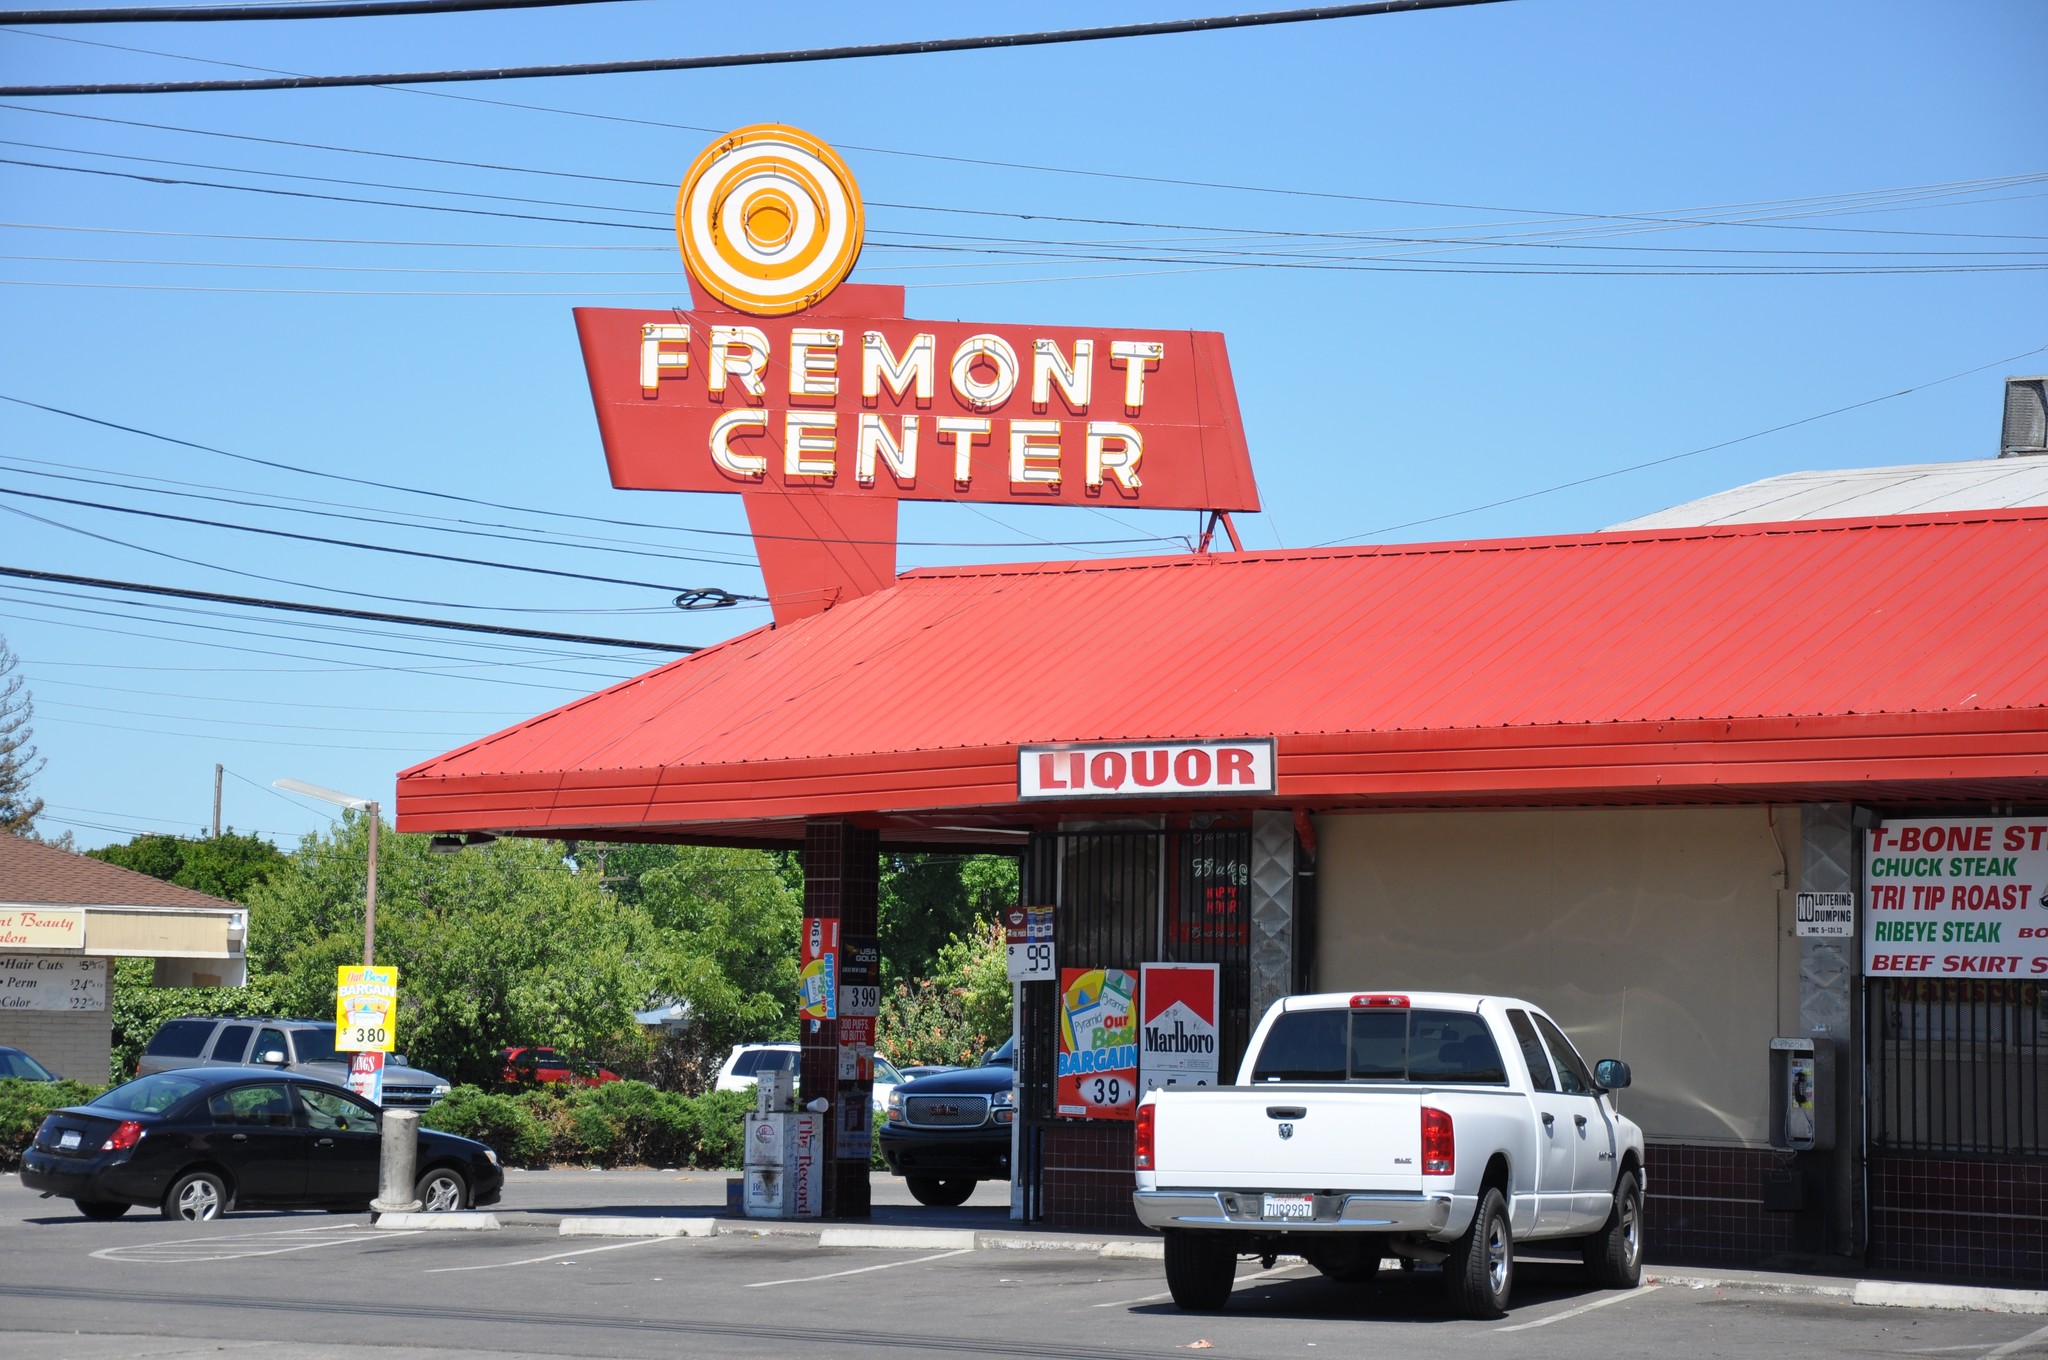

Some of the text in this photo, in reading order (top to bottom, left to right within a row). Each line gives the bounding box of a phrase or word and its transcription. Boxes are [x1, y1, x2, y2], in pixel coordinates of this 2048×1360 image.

[640, 323, 1163, 407] FREMONT
[710, 409, 1143, 488] CENTER
[1039, 748, 1255, 791] LIQUOR
[1870, 825, 2048, 852] T-BONE ST
[1871, 857, 2018, 877] CHUCK STEAK
[1799, 894, 1813, 921] NO
[1815, 894, 1851, 906] LOITERING
[1870, 884, 2032, 911] TRI TIP ROAST
[21, 912, 74, 931] Beauty
[1815, 910, 1851, 922] DUMPING
[1875, 921, 1938, 942] RIBEYE
[1942, 921, 2002, 943] STEAK
[5, 958, 33, 970] Hair
[37, 959, 64, 970] Cuts
[1872, 955, 1935, 971] BEEF
[1942, 955, 2023, 973] SKIRT
[7, 977, 37, 987] Perm
[340, 984, 396, 997] BARGAIN
[824, 952, 836, 1019] BARGAIN
[2, 996, 31, 1007] Color
[1101, 992, 1128, 1014] Pyramid
[1074, 1011, 1103, 1033] Pyramid
[1104, 1015, 1129, 1029] Our
[356, 1028, 385, 1042] 380
[1091, 1026, 1135, 1050] Best
[1145, 1021, 1214, 1053] Marlboro
[1058, 1044, 1138, 1077] BARGAIN
[798, 1116, 813, 1215] The Record
